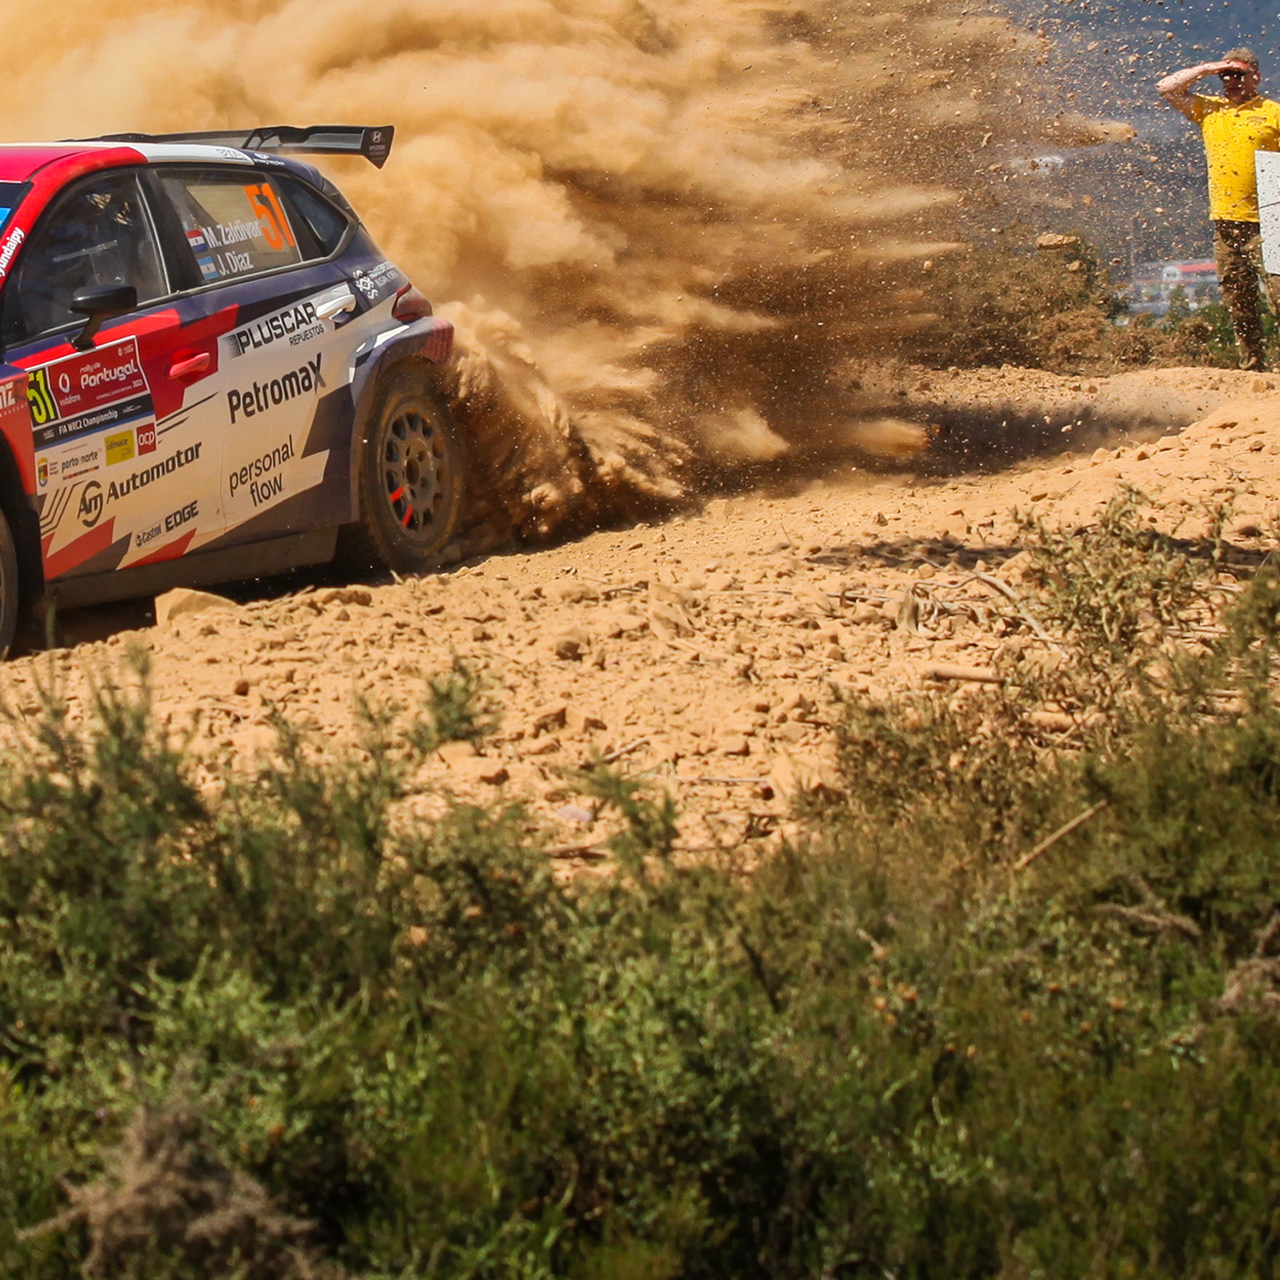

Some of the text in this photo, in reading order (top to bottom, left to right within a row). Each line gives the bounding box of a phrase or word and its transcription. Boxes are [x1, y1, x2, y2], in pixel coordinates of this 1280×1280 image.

[243, 183, 295, 250] 51
[202, 226, 222, 249] M.
[217, 254, 230, 276] J.
[239, 302, 319, 353] PLUSCAR
[289, 324, 325, 346] REPUESTOS
[81, 359, 139, 389] Portugal
[27, 370, 55, 424] 51
[58, 425, 68, 435] FIA
[83, 410, 118, 427] Championship
[106, 442, 202, 505] Automotor
[229, 434, 295, 497] personal
[249, 473, 283, 507] flow
[165, 499, 200, 532] EDGE
